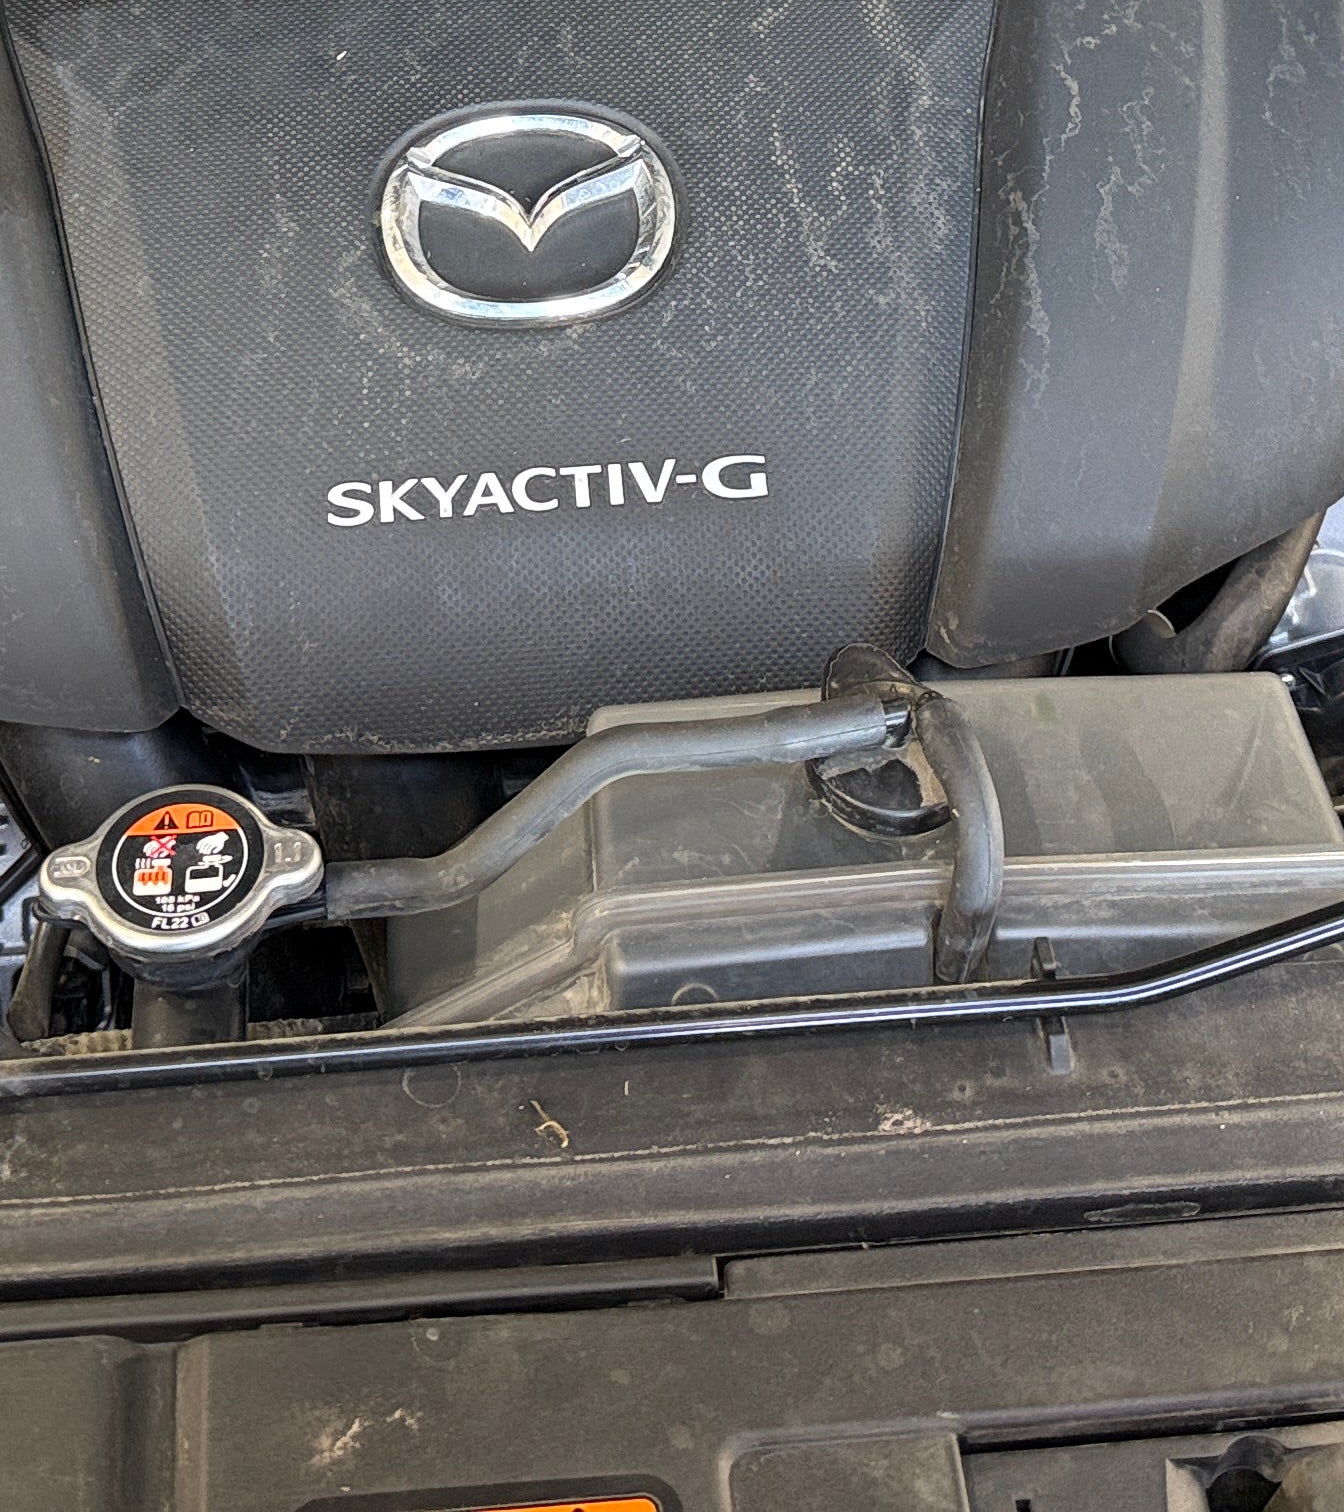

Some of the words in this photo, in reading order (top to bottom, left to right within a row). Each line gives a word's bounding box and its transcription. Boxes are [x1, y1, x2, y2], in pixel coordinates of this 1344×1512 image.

[326, 454, 770, 527] SKYACTIV-G
[273, 841, 302, 863] 1.1
[150, 916, 190, 930] FL22
